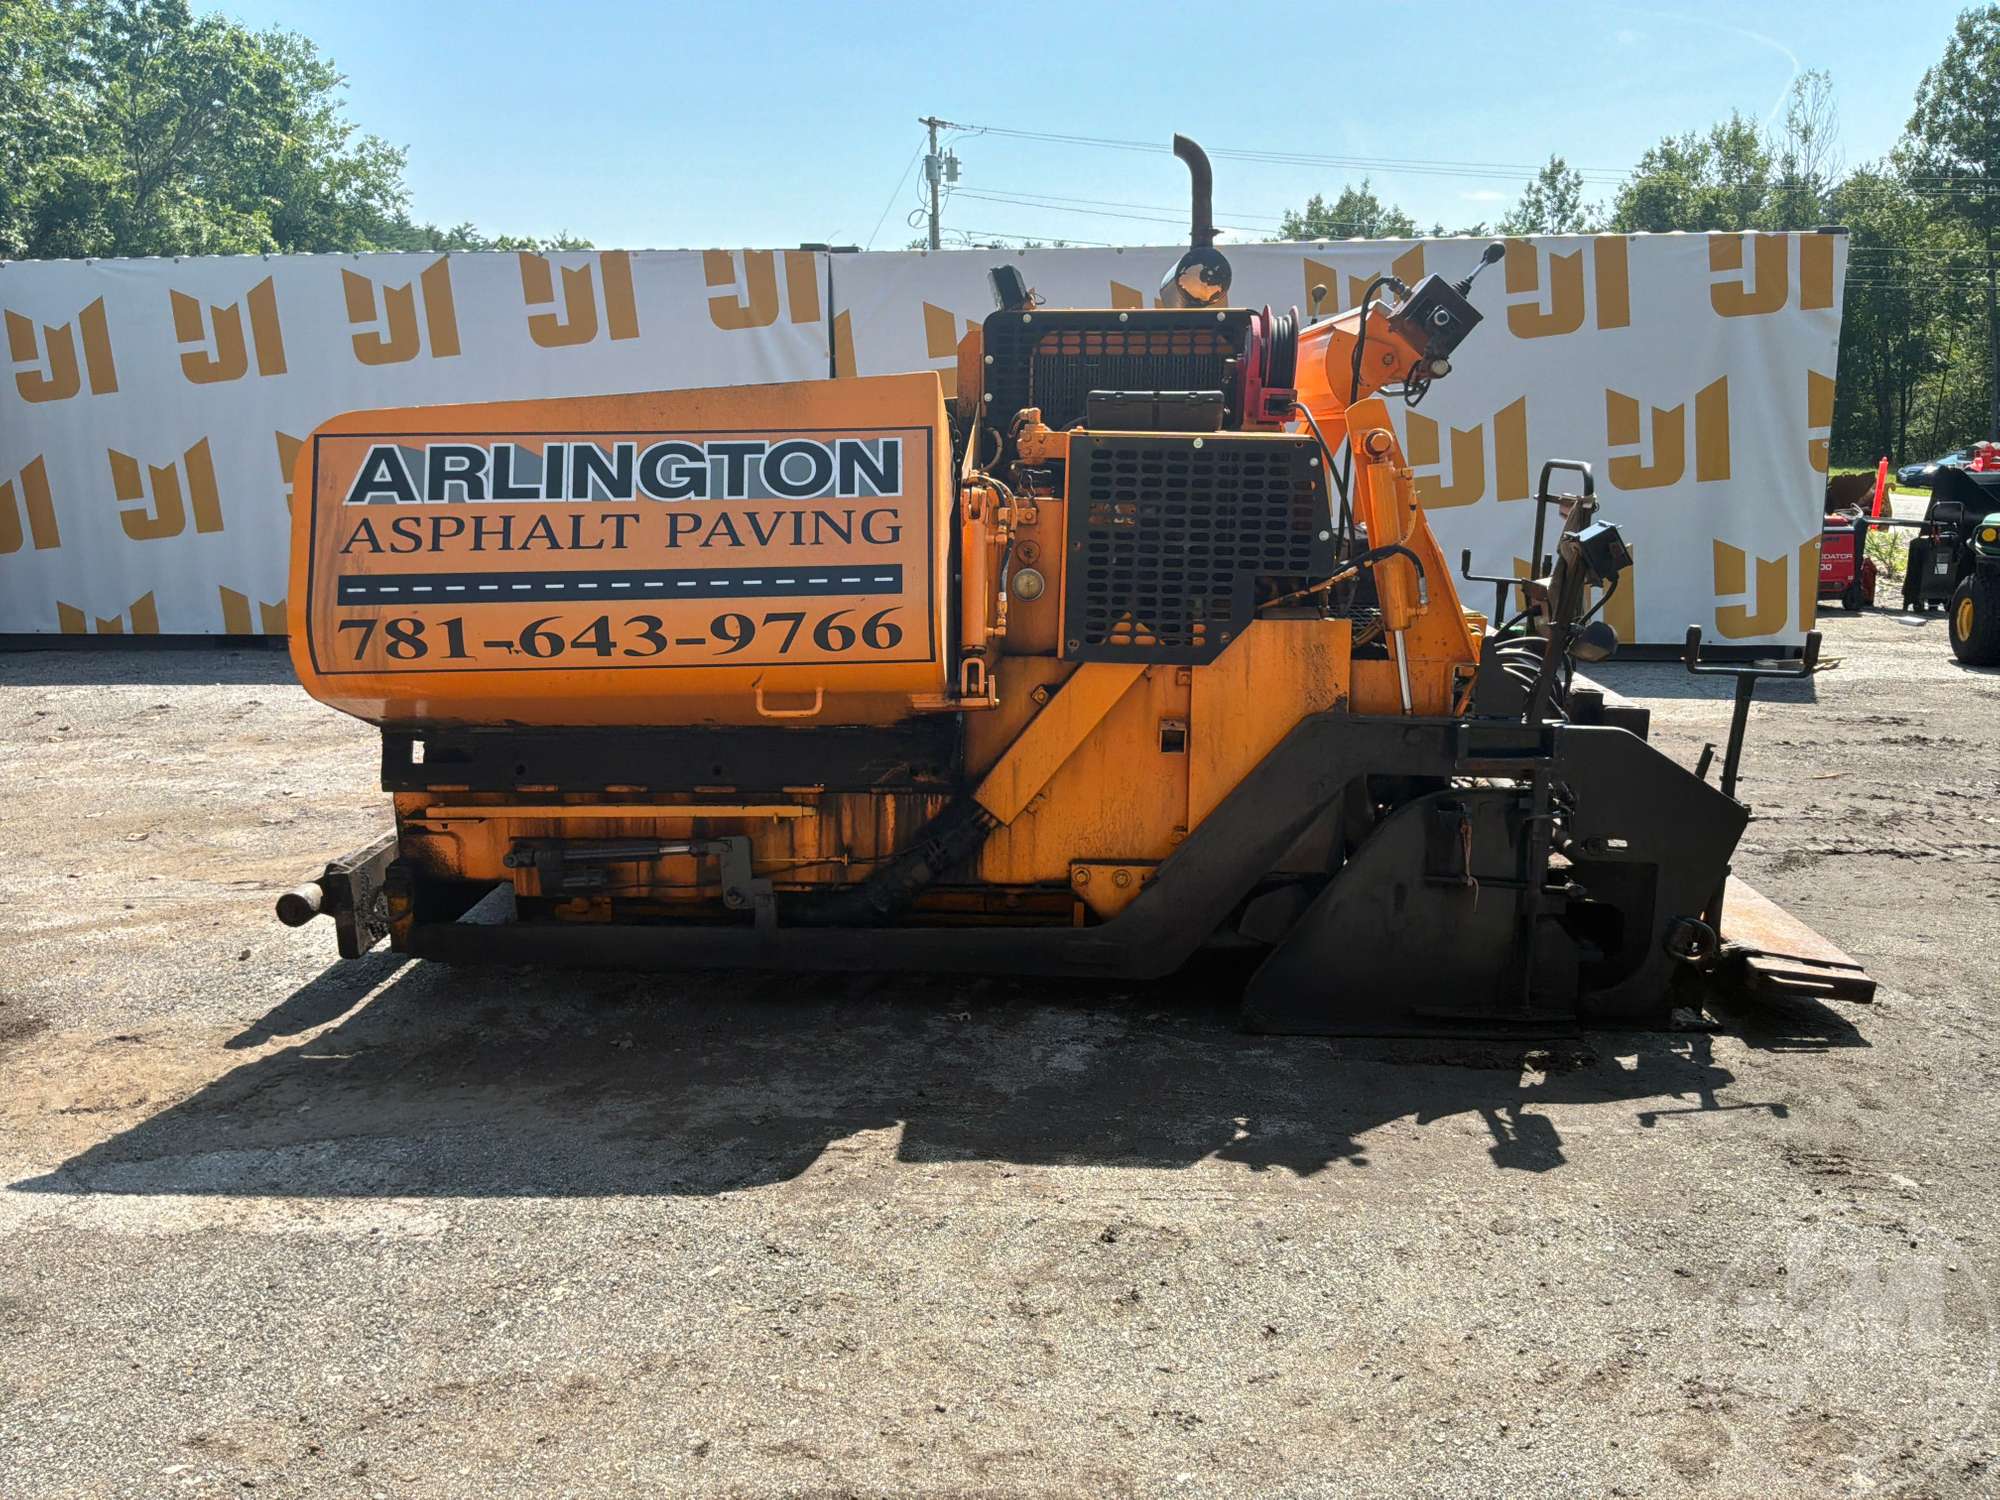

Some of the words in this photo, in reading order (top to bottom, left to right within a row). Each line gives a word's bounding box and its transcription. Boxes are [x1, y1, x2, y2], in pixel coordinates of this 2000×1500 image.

[342, 437, 902, 505] ARLINGTON
[340, 513, 641, 554] ASPHALT
[664, 508, 904, 549] PAVING
[337, 605, 904, 661] 781-643-9766
